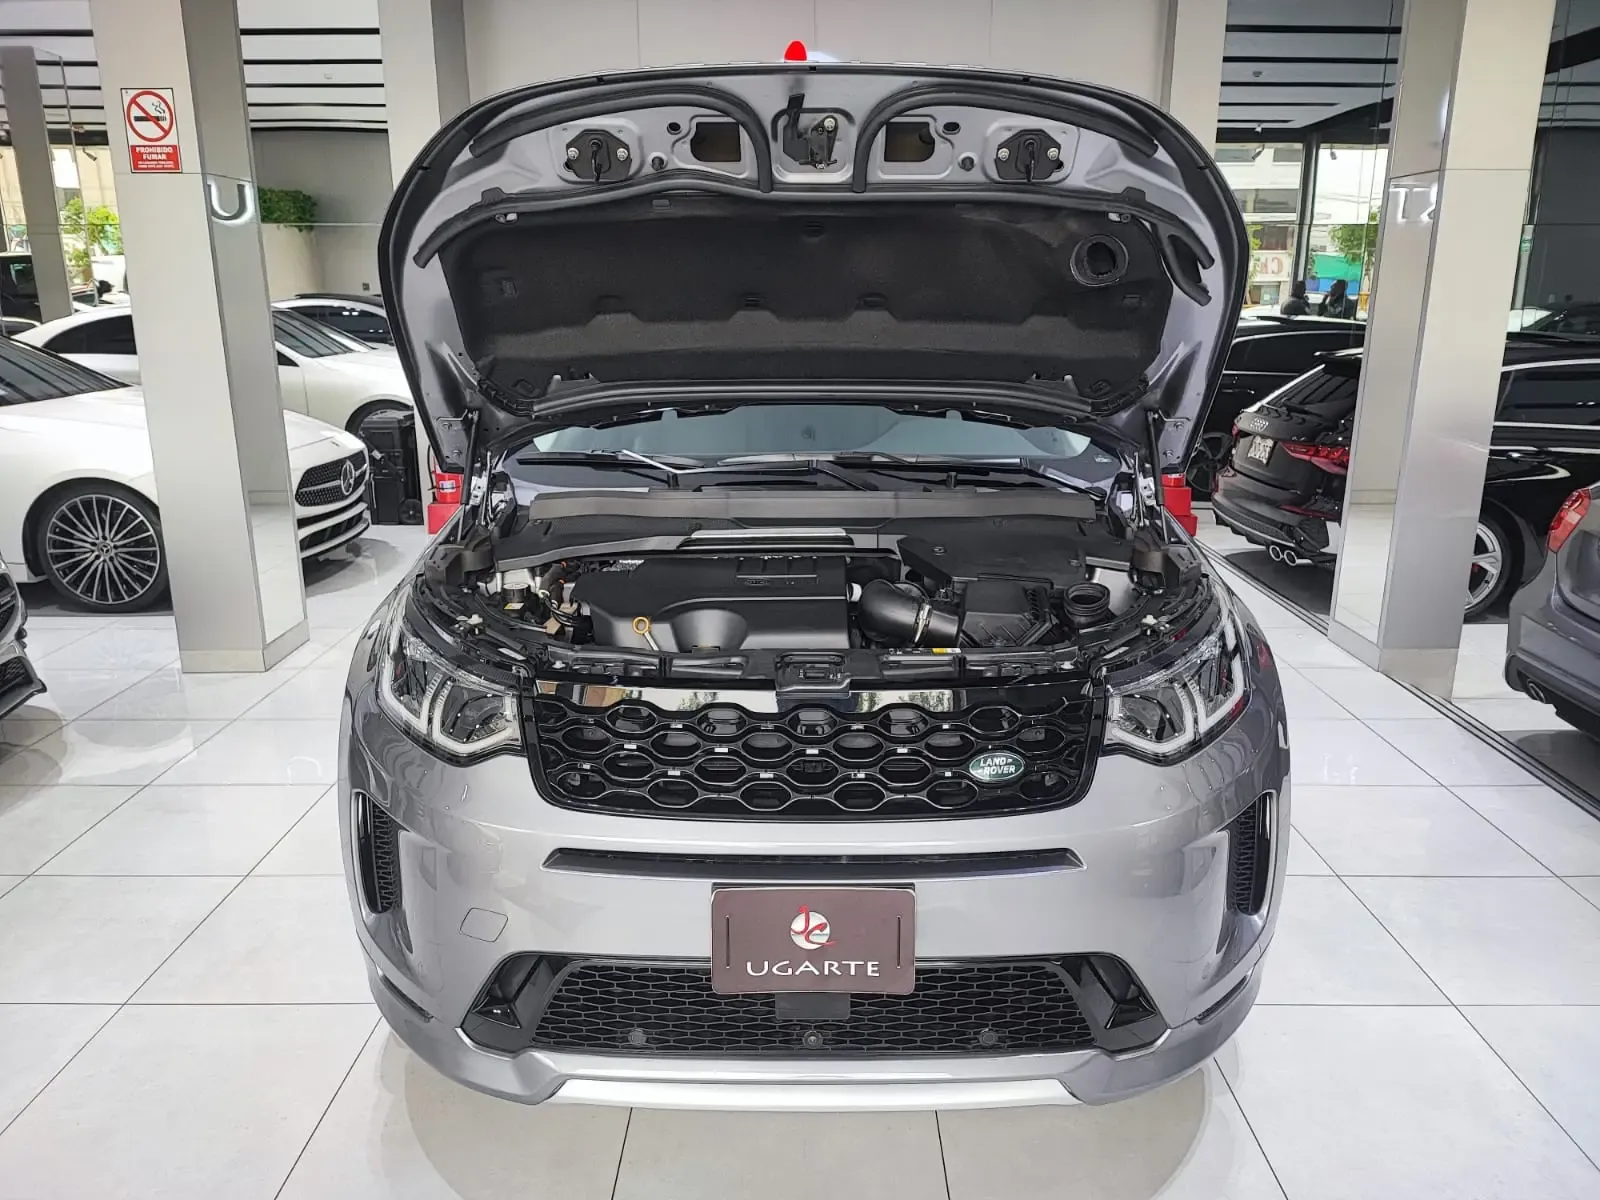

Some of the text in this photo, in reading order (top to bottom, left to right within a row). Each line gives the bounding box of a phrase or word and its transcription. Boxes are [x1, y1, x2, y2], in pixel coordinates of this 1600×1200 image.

[980, 757, 1006, 766] LAND
[983, 765, 1015, 774] ROVER
[746, 960, 880, 977] UGARTE
